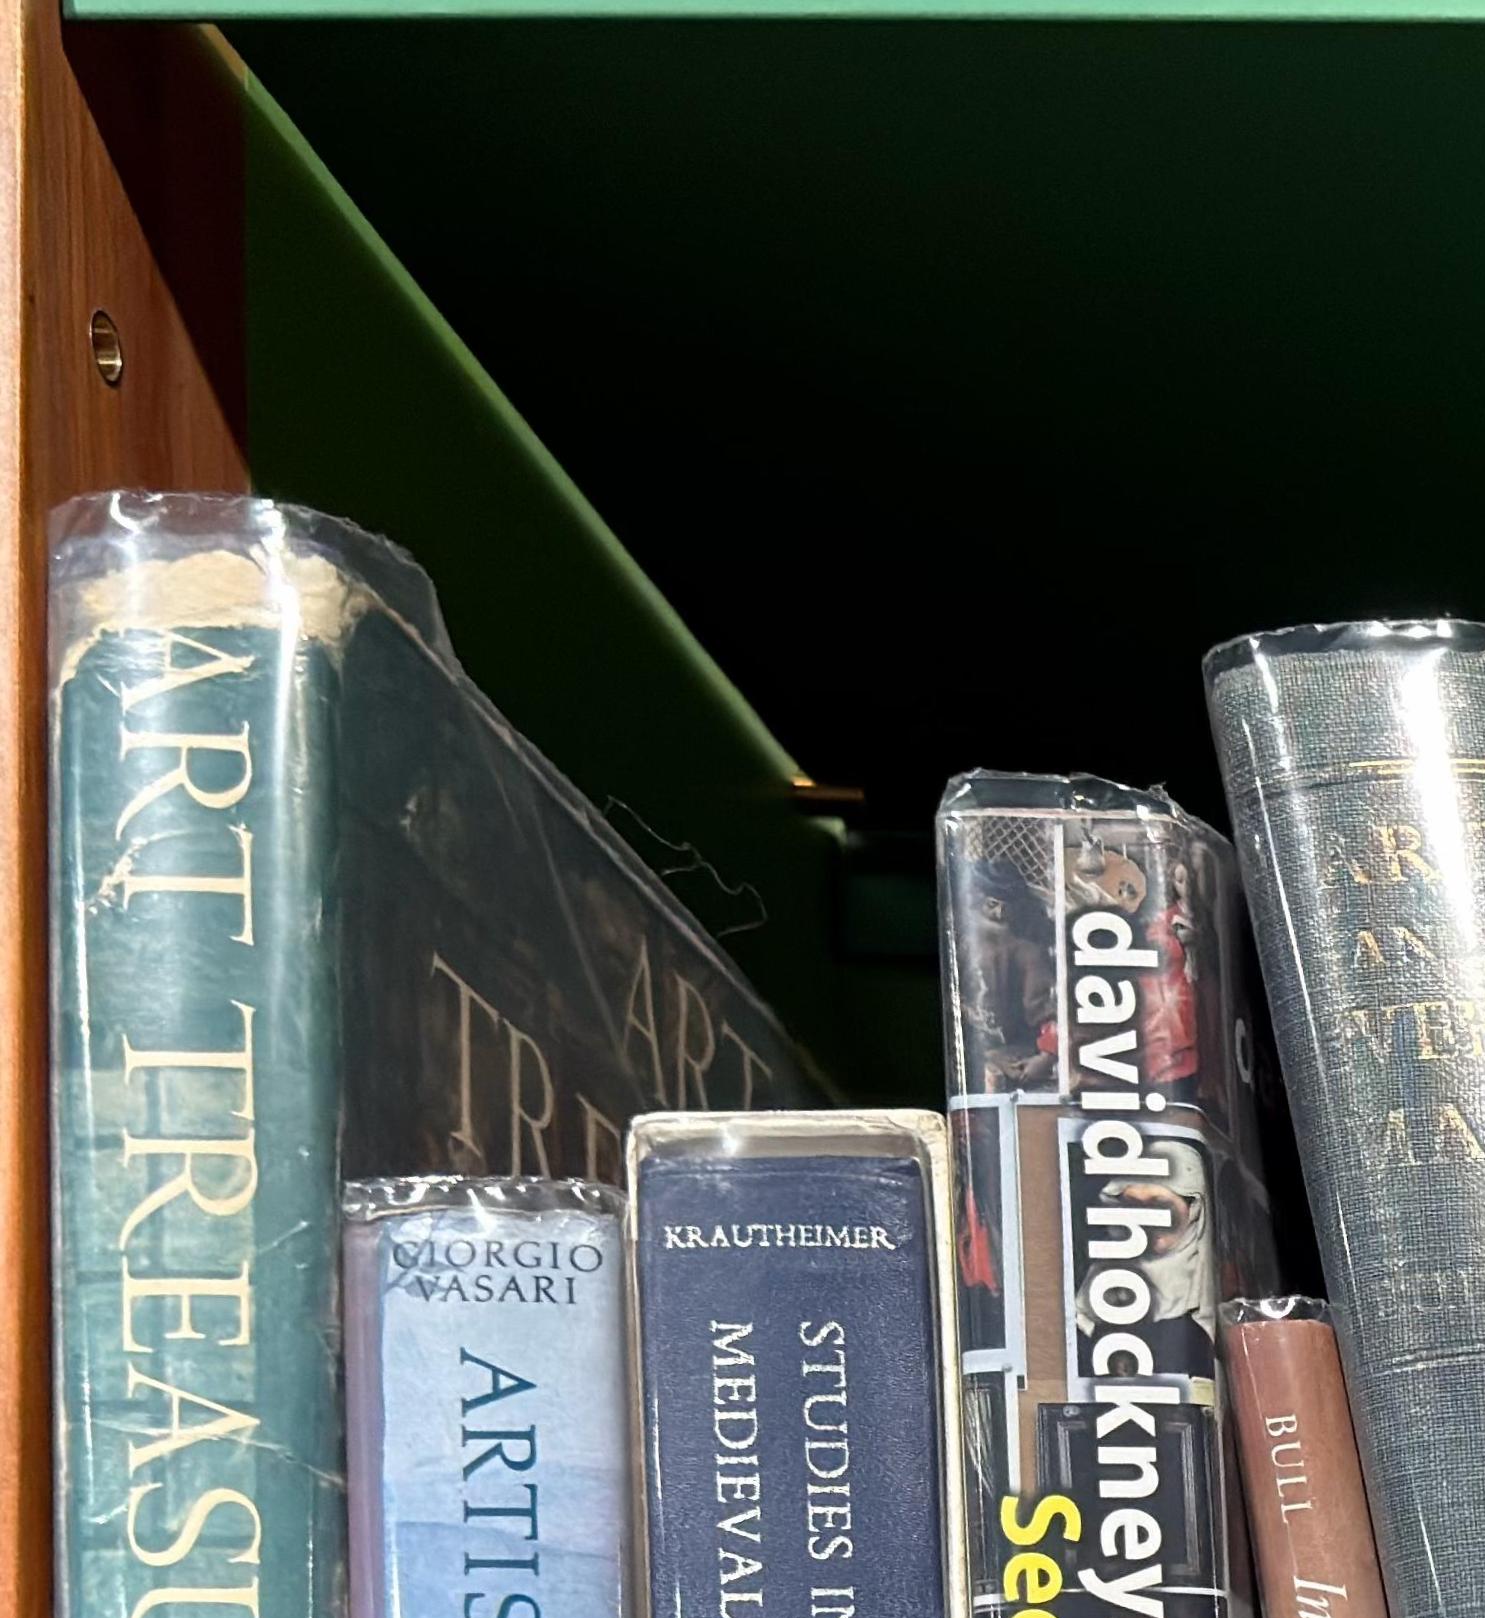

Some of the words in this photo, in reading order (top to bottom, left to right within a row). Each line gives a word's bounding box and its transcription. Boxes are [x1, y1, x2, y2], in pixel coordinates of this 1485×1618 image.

[116, 628, 256, 946] ART
[1070, 910, 1168, 1177] david
[392, 1239, 604, 1275] GIORGIO
[414, 1274, 580, 1308] VASARI
[663, 1223, 897, 1253] KRAUTHEIMER
[800, 1320, 853, 1563] STUDIES
[1265, 1411, 1313, 1525] BULL
